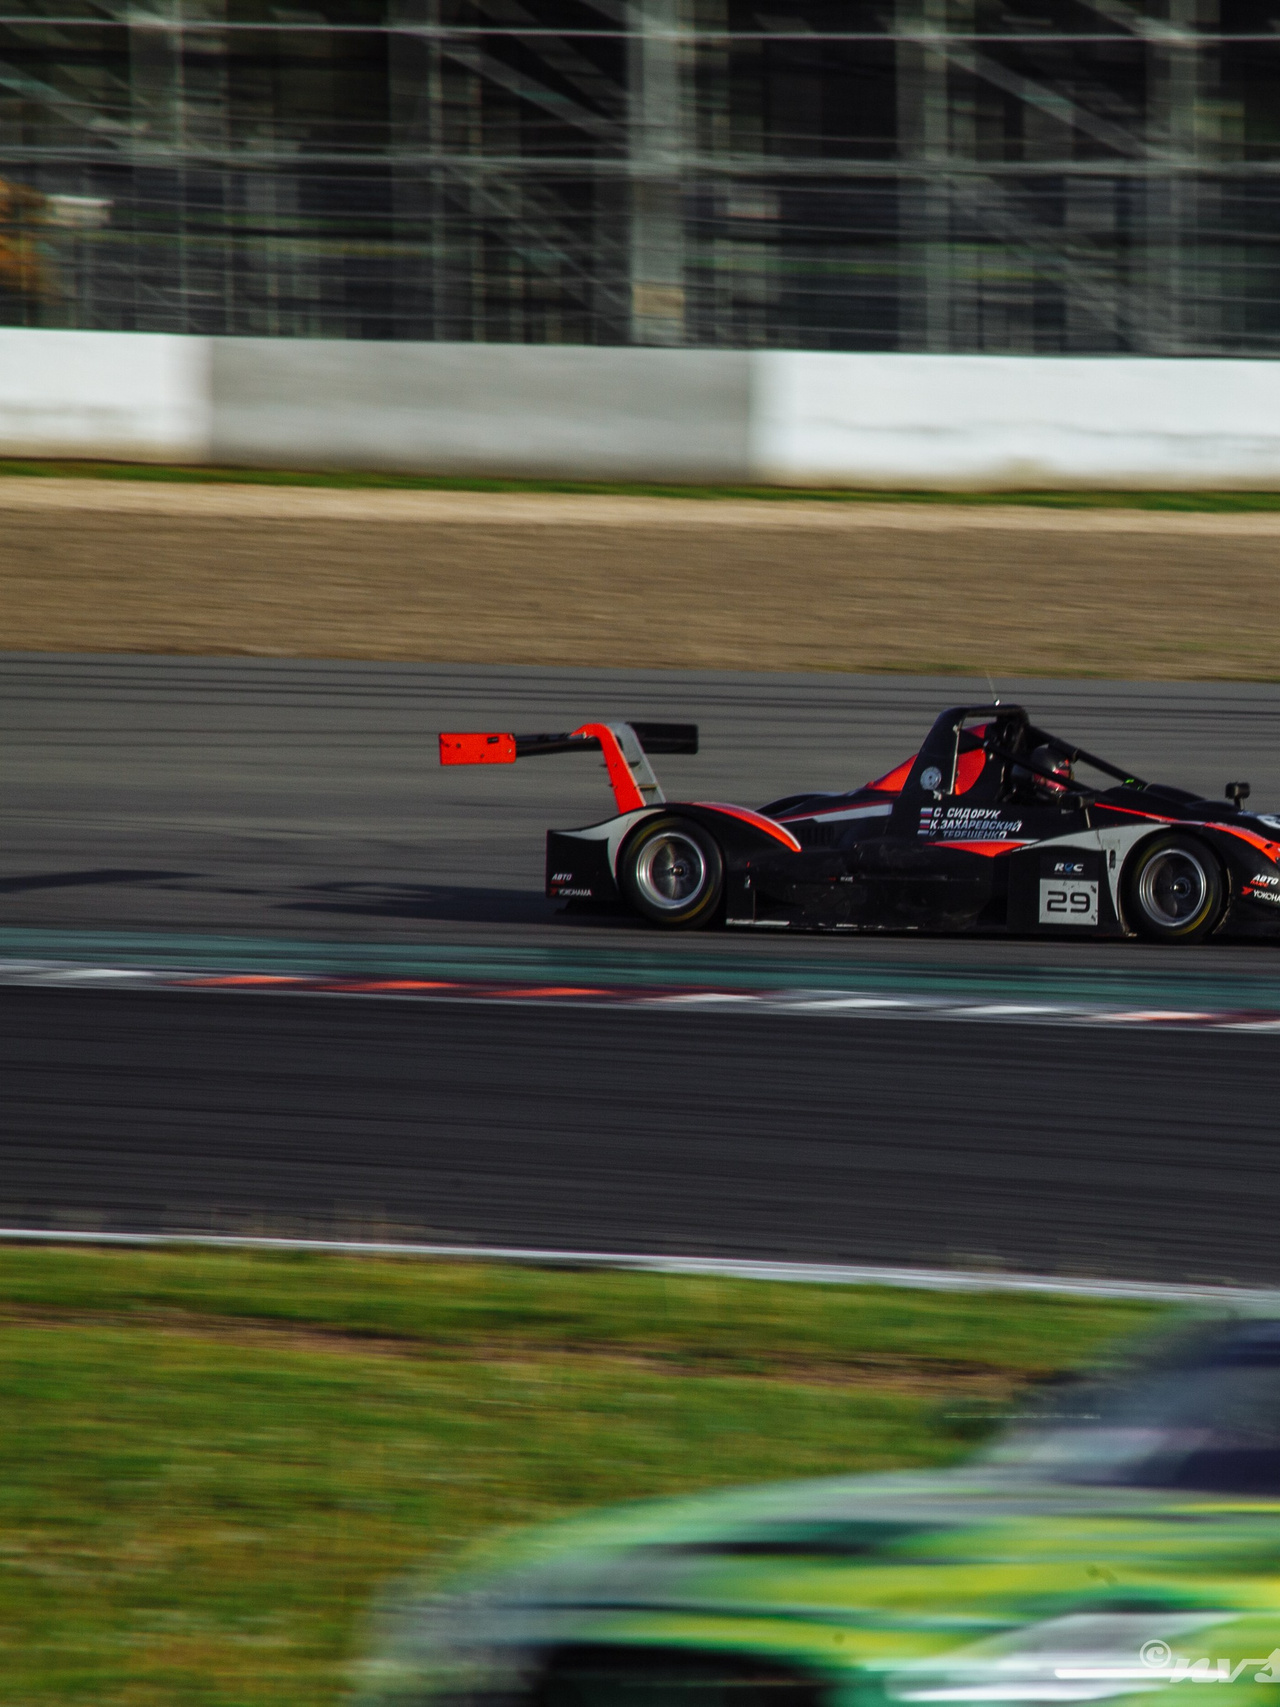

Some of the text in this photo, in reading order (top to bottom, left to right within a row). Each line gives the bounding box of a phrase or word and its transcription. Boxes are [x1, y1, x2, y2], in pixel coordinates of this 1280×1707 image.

[933, 807, 1001, 819] С. СИДОРУК
[1046, 890, 1091, 914] 29
